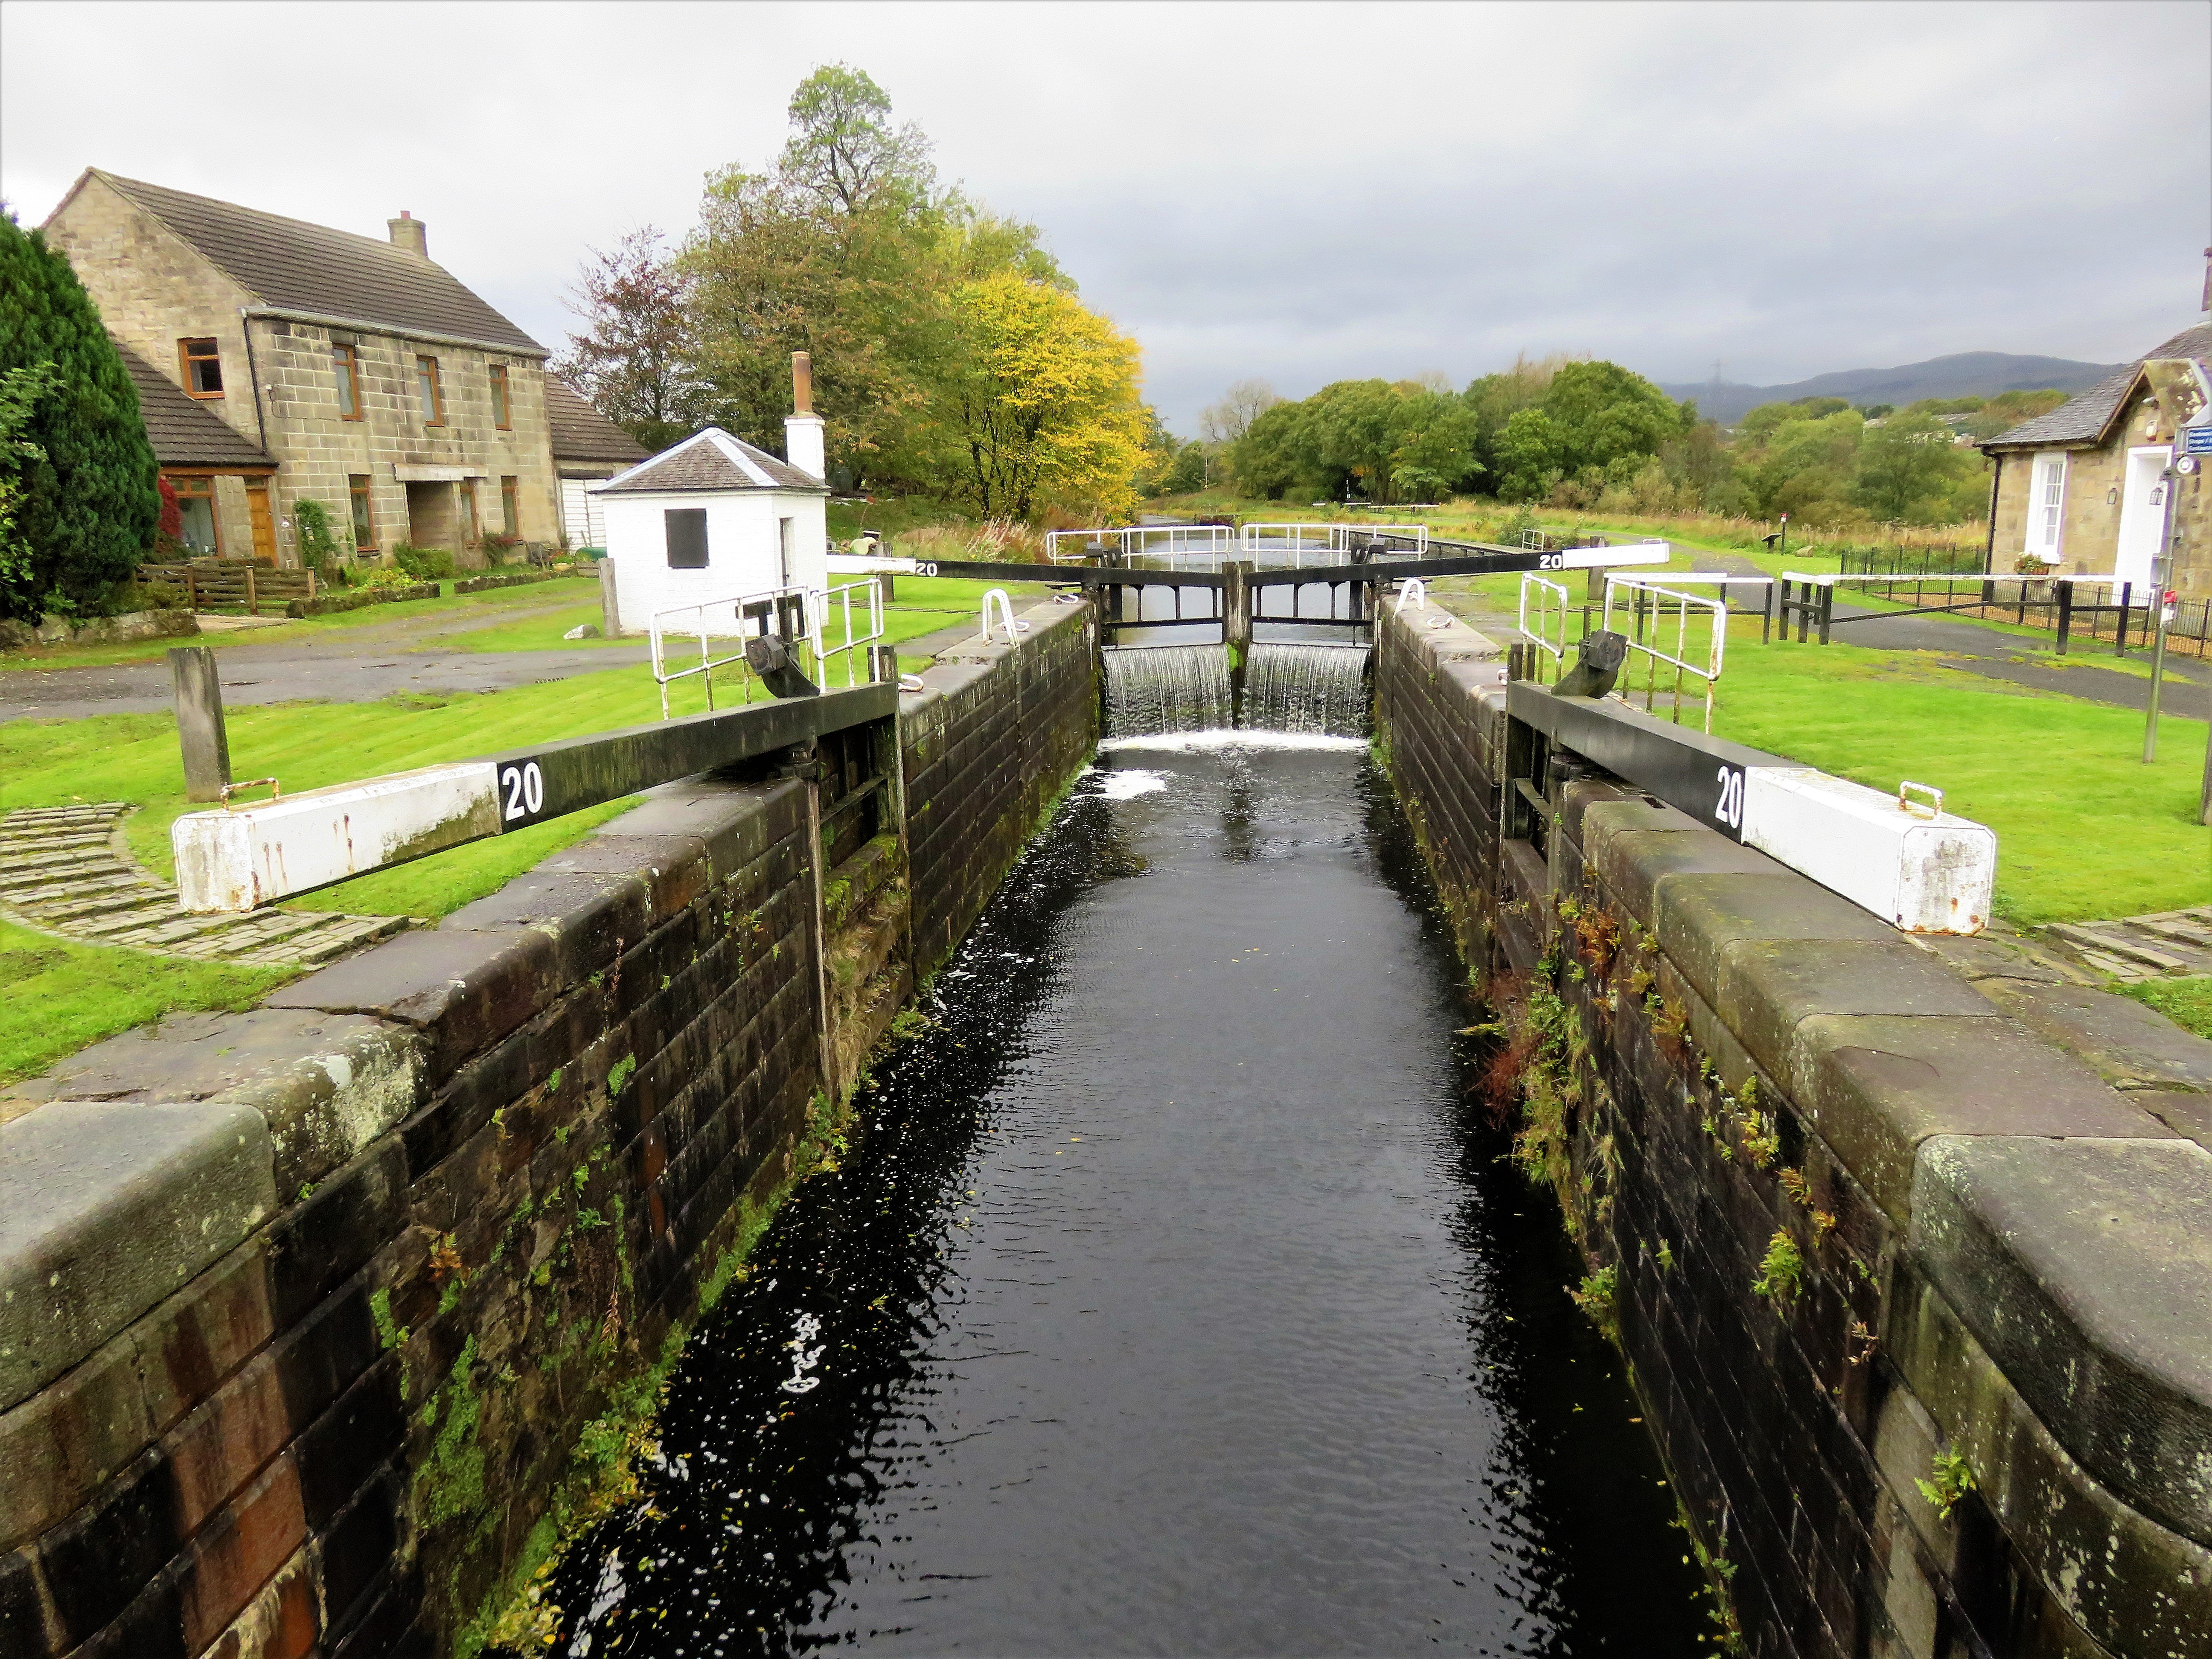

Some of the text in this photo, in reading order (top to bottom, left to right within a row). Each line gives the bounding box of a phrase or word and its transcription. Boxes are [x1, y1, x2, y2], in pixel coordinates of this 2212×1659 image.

[916, 562, 937, 577] 20
[1540, 554, 1562, 569] 20
[503, 762, 543, 821] 20
[1715, 766, 1742, 829] 20
